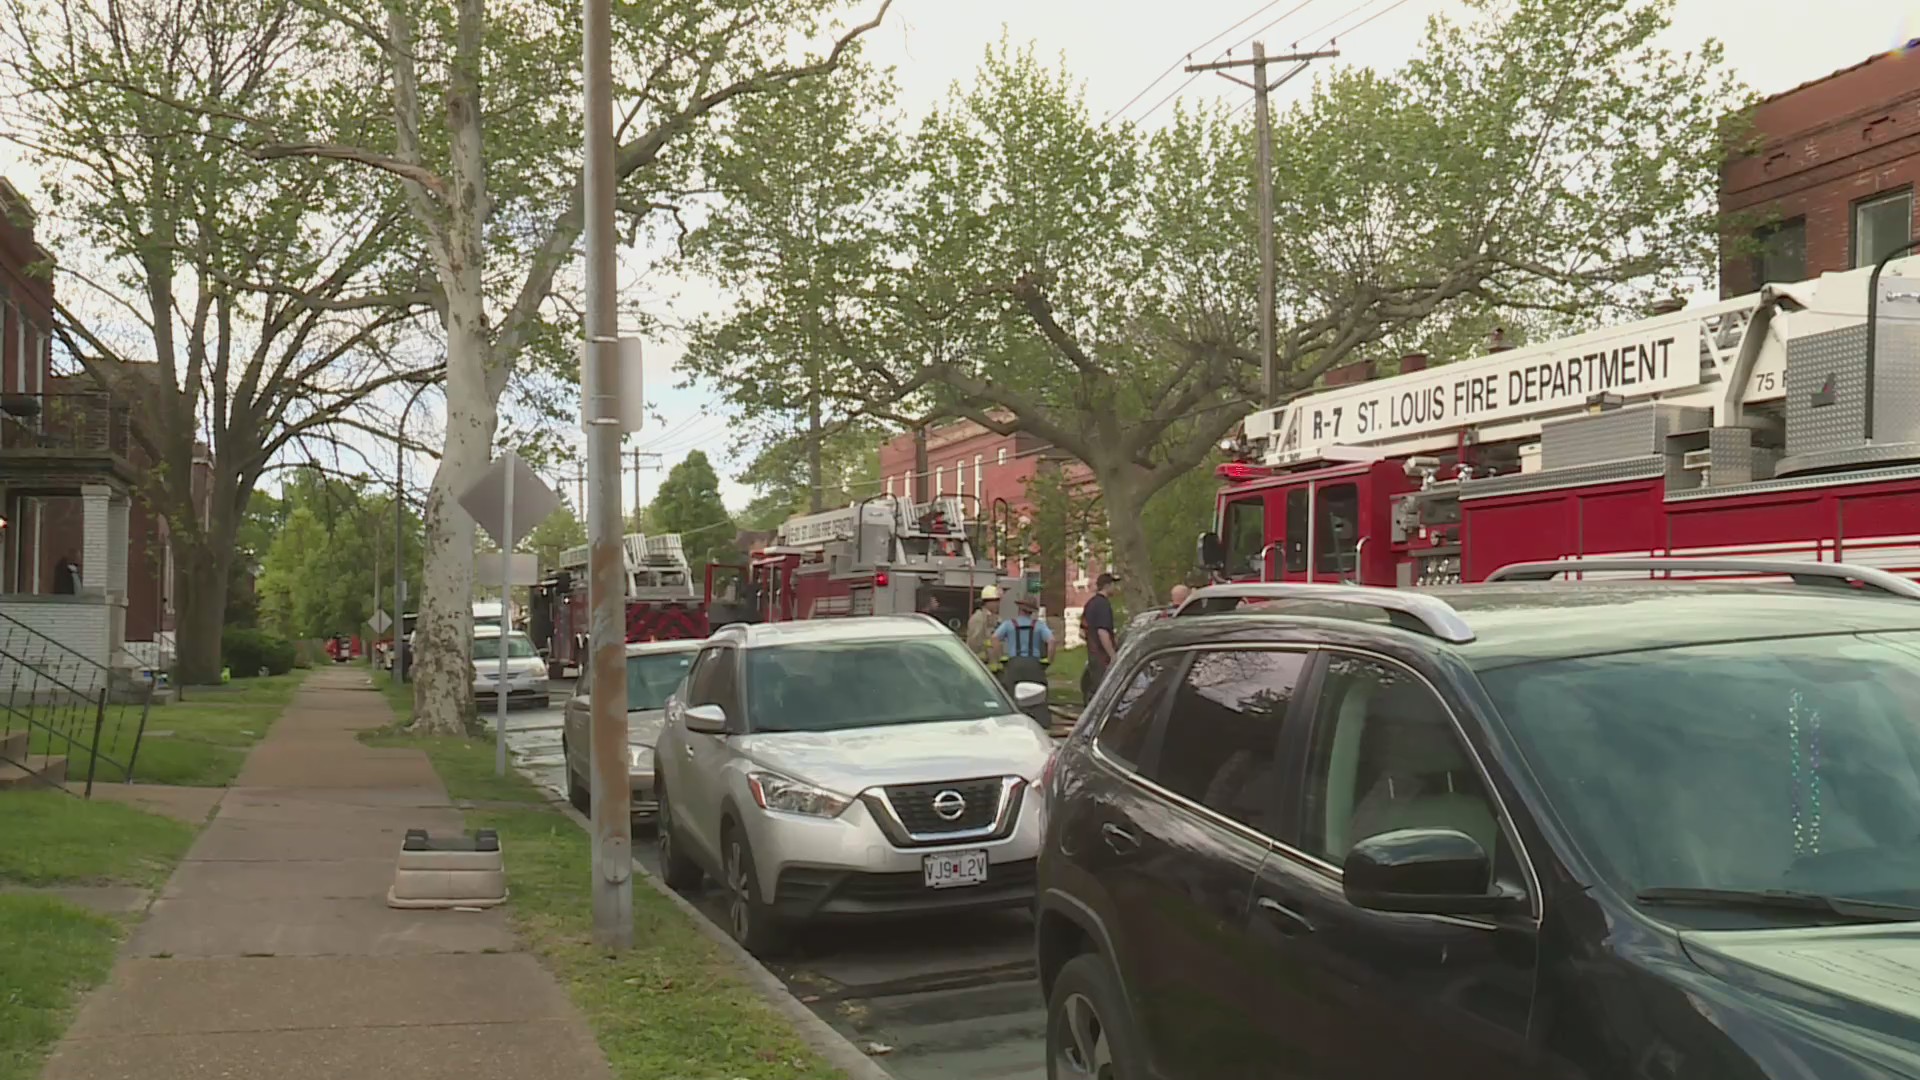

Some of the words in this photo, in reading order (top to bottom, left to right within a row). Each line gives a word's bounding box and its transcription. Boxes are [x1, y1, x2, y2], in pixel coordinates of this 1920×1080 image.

[1313, 407, 1342, 439] R-7
[1357, 400, 1383, 434] ST.
[1390, 386, 1444, 427] LOUIS
[1454, 376, 1498, 416] FIRE
[1508, 338, 1674, 405] DEPARTMENT
[1756, 372, 1774, 392] 75
